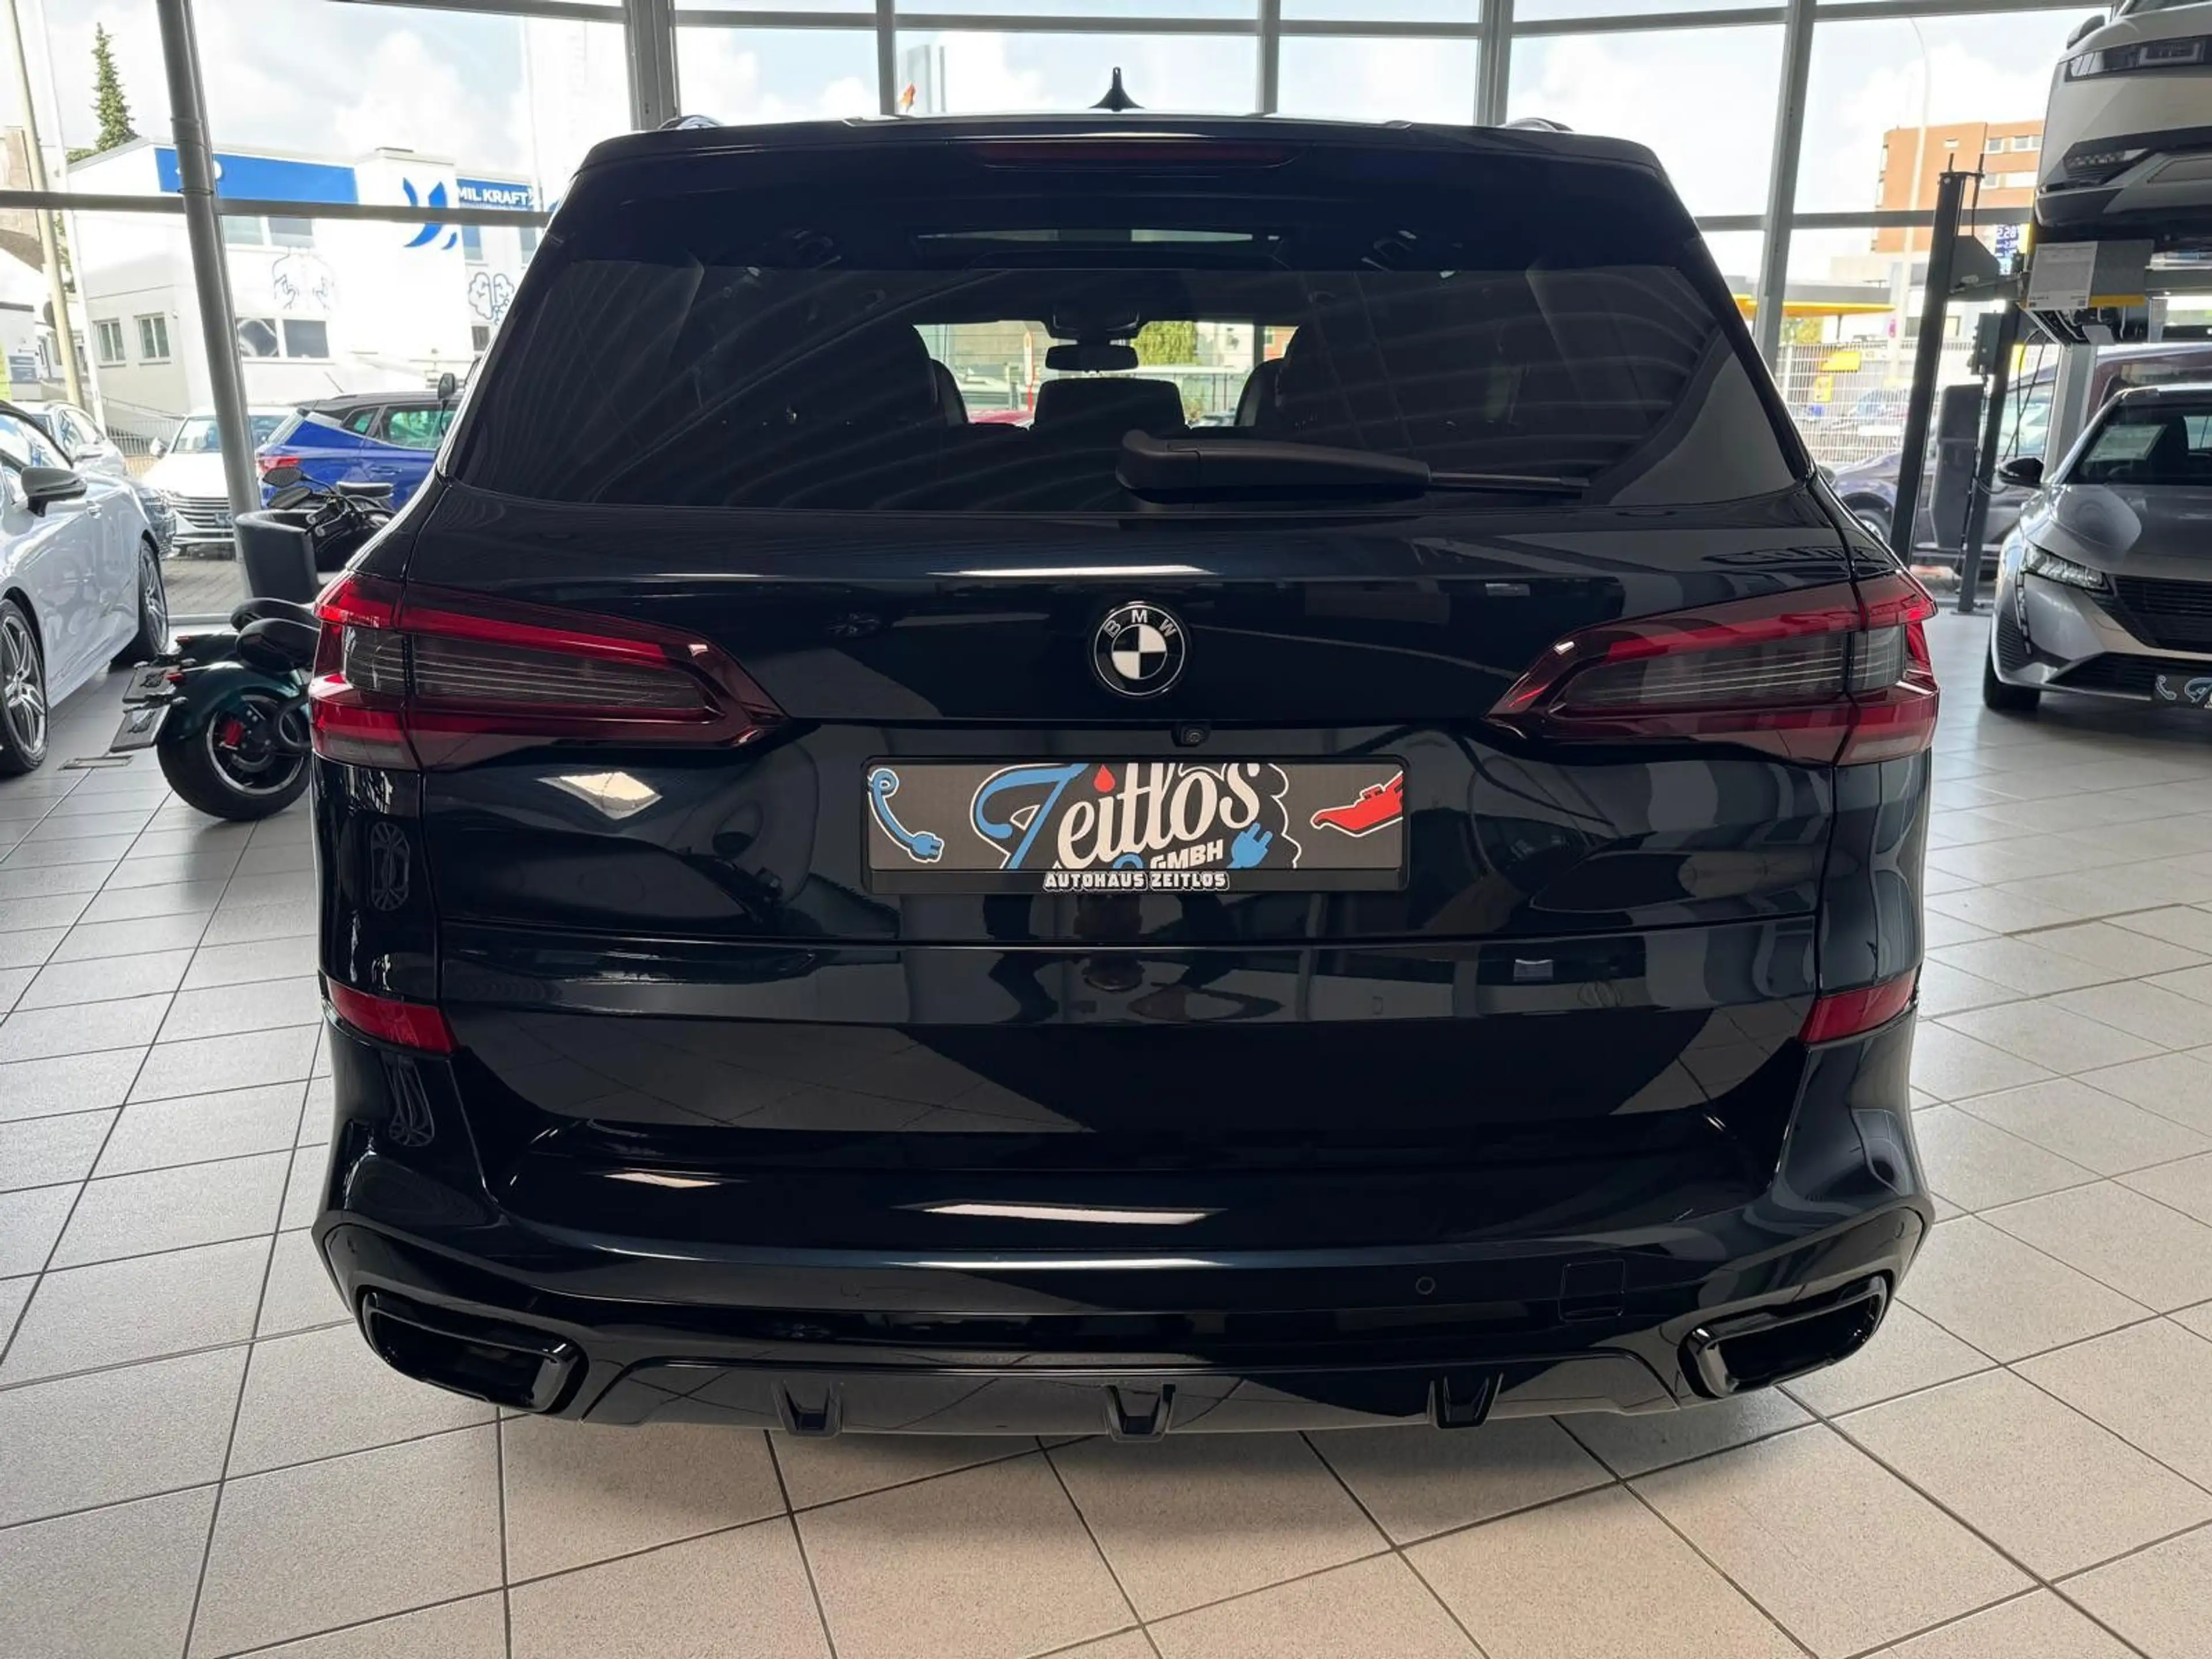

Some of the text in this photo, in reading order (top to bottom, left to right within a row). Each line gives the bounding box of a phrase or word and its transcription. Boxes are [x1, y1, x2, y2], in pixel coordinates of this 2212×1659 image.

[483, 188, 527, 206] KRAFT
[1103, 609, 1177, 638] BMW
[1044, 872, 1228, 889] AUTOHAUS ZEITLOS
